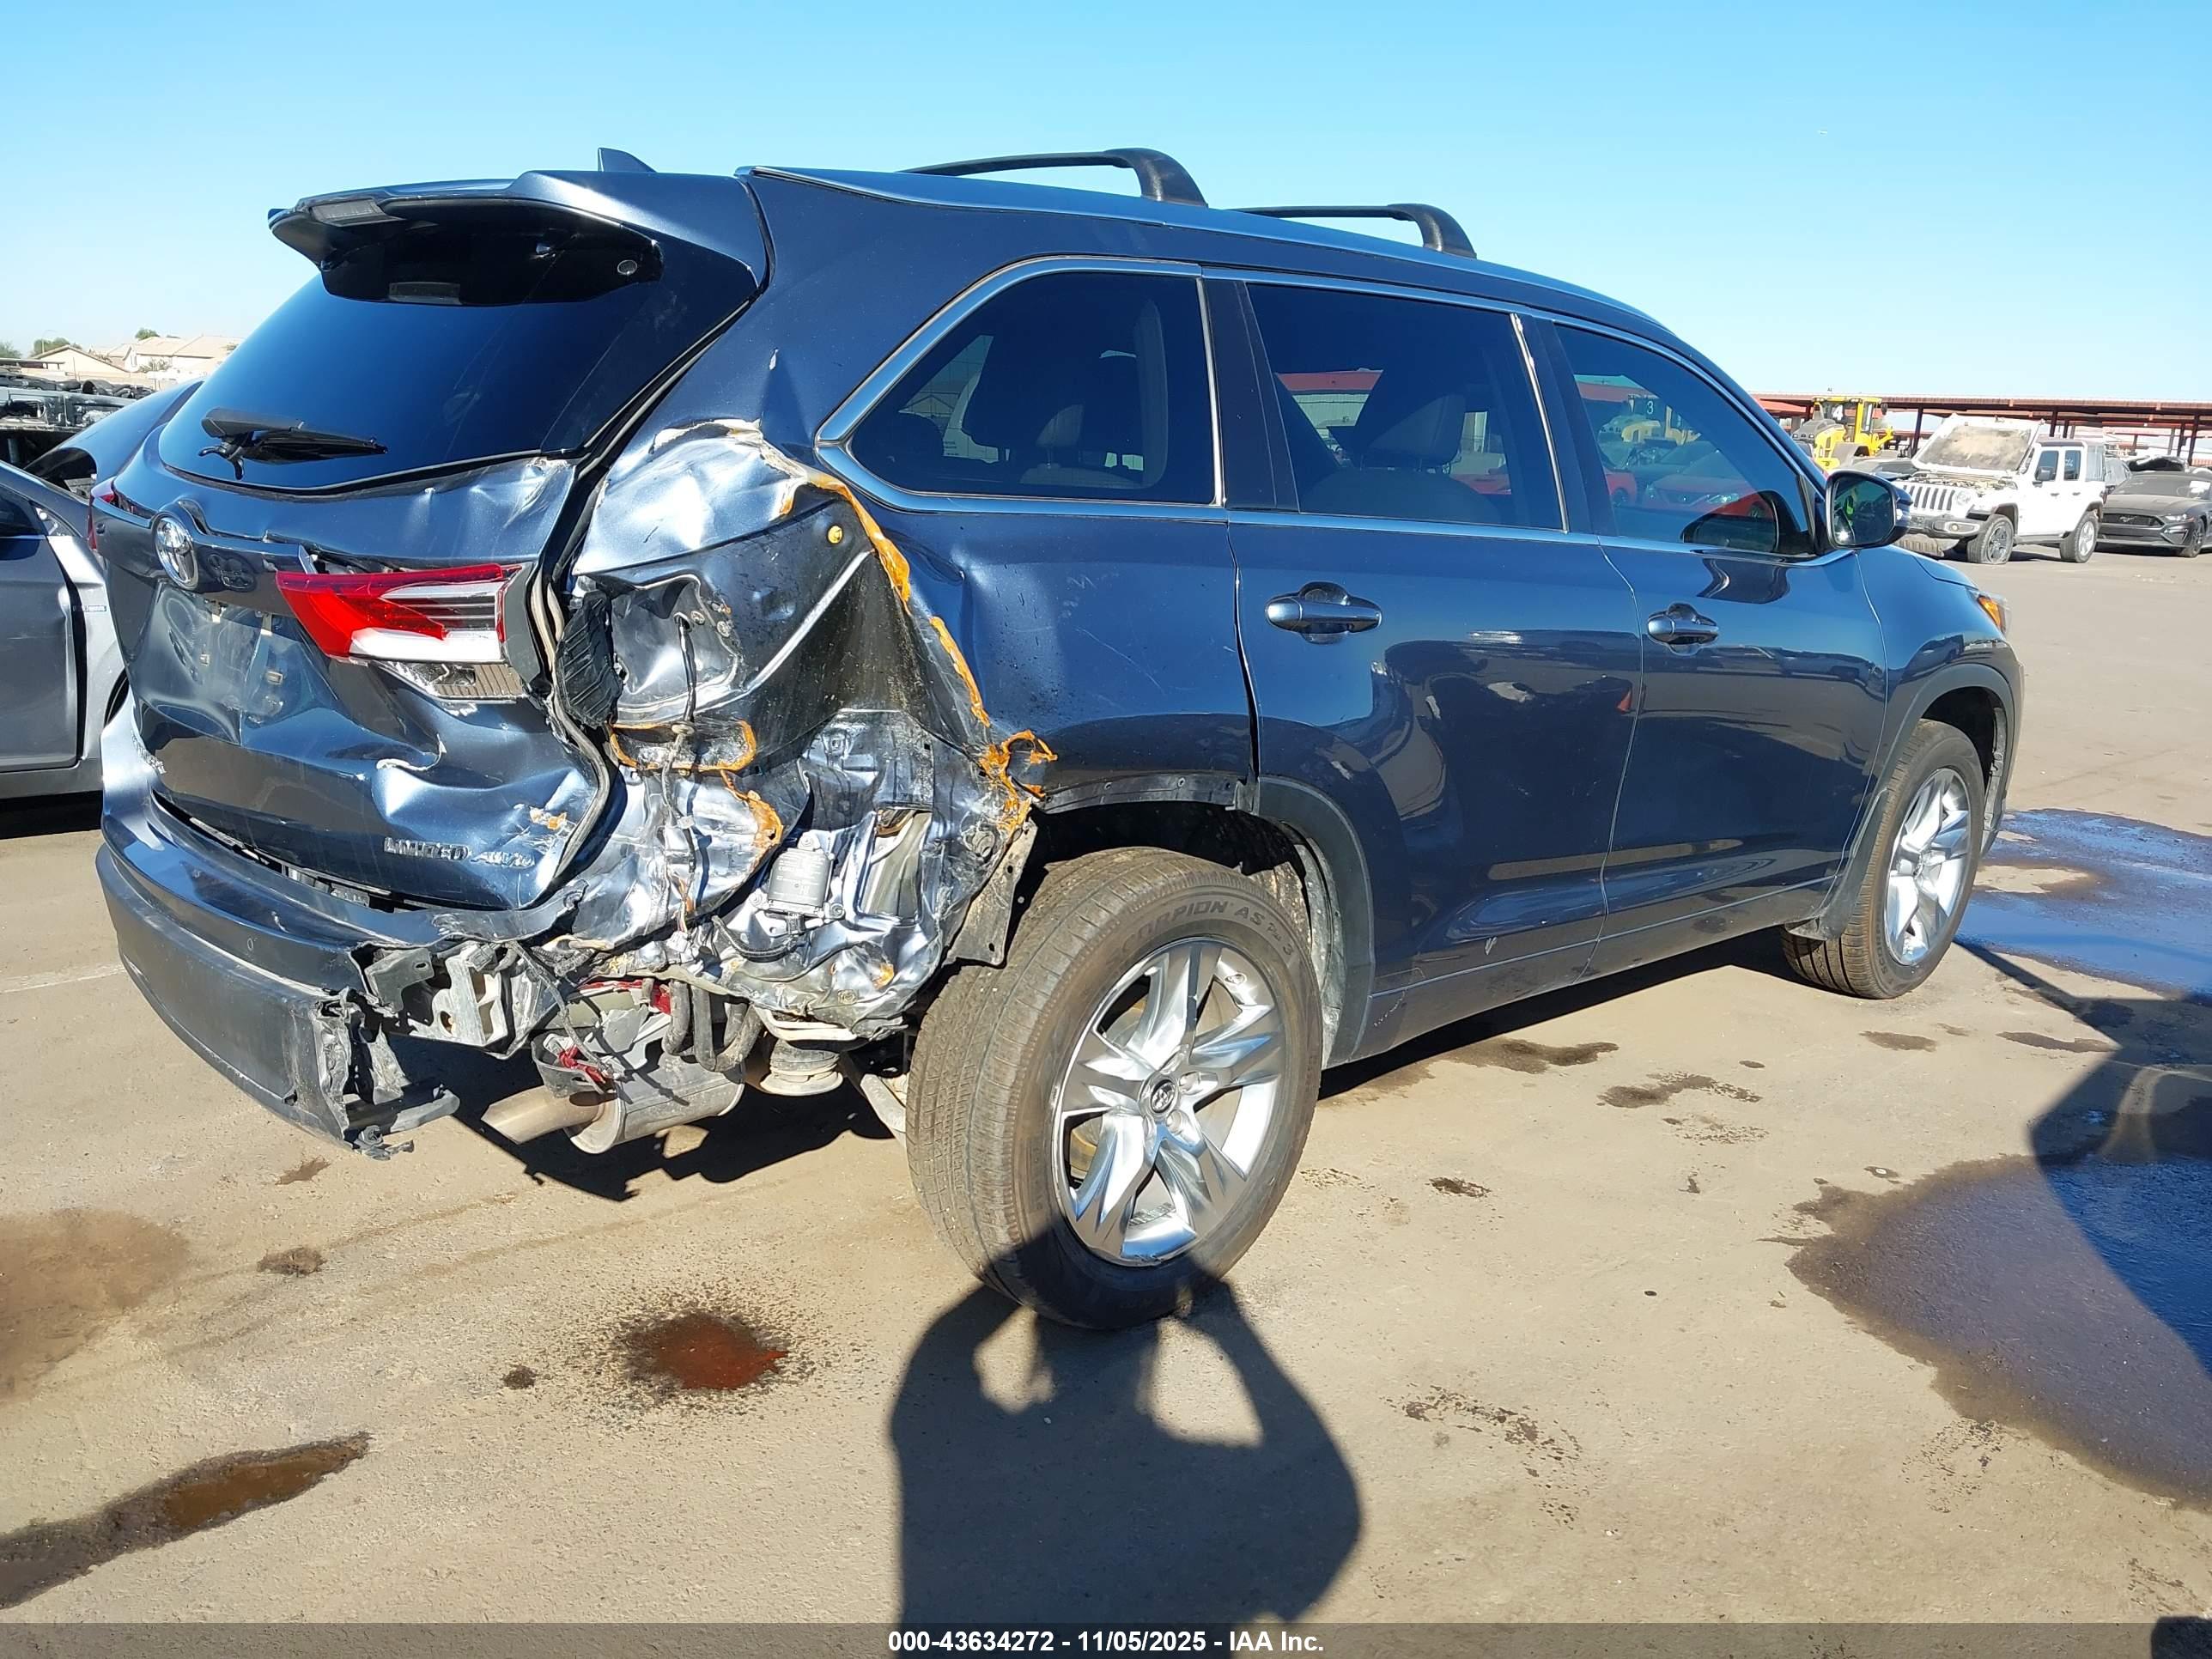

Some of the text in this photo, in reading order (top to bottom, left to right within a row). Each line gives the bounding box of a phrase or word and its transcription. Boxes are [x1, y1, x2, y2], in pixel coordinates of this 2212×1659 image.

[1646, 399, 1655, 415] 3
[383, 836, 470, 861] LIMITED
[1234, 906, 1265, 927] AS
